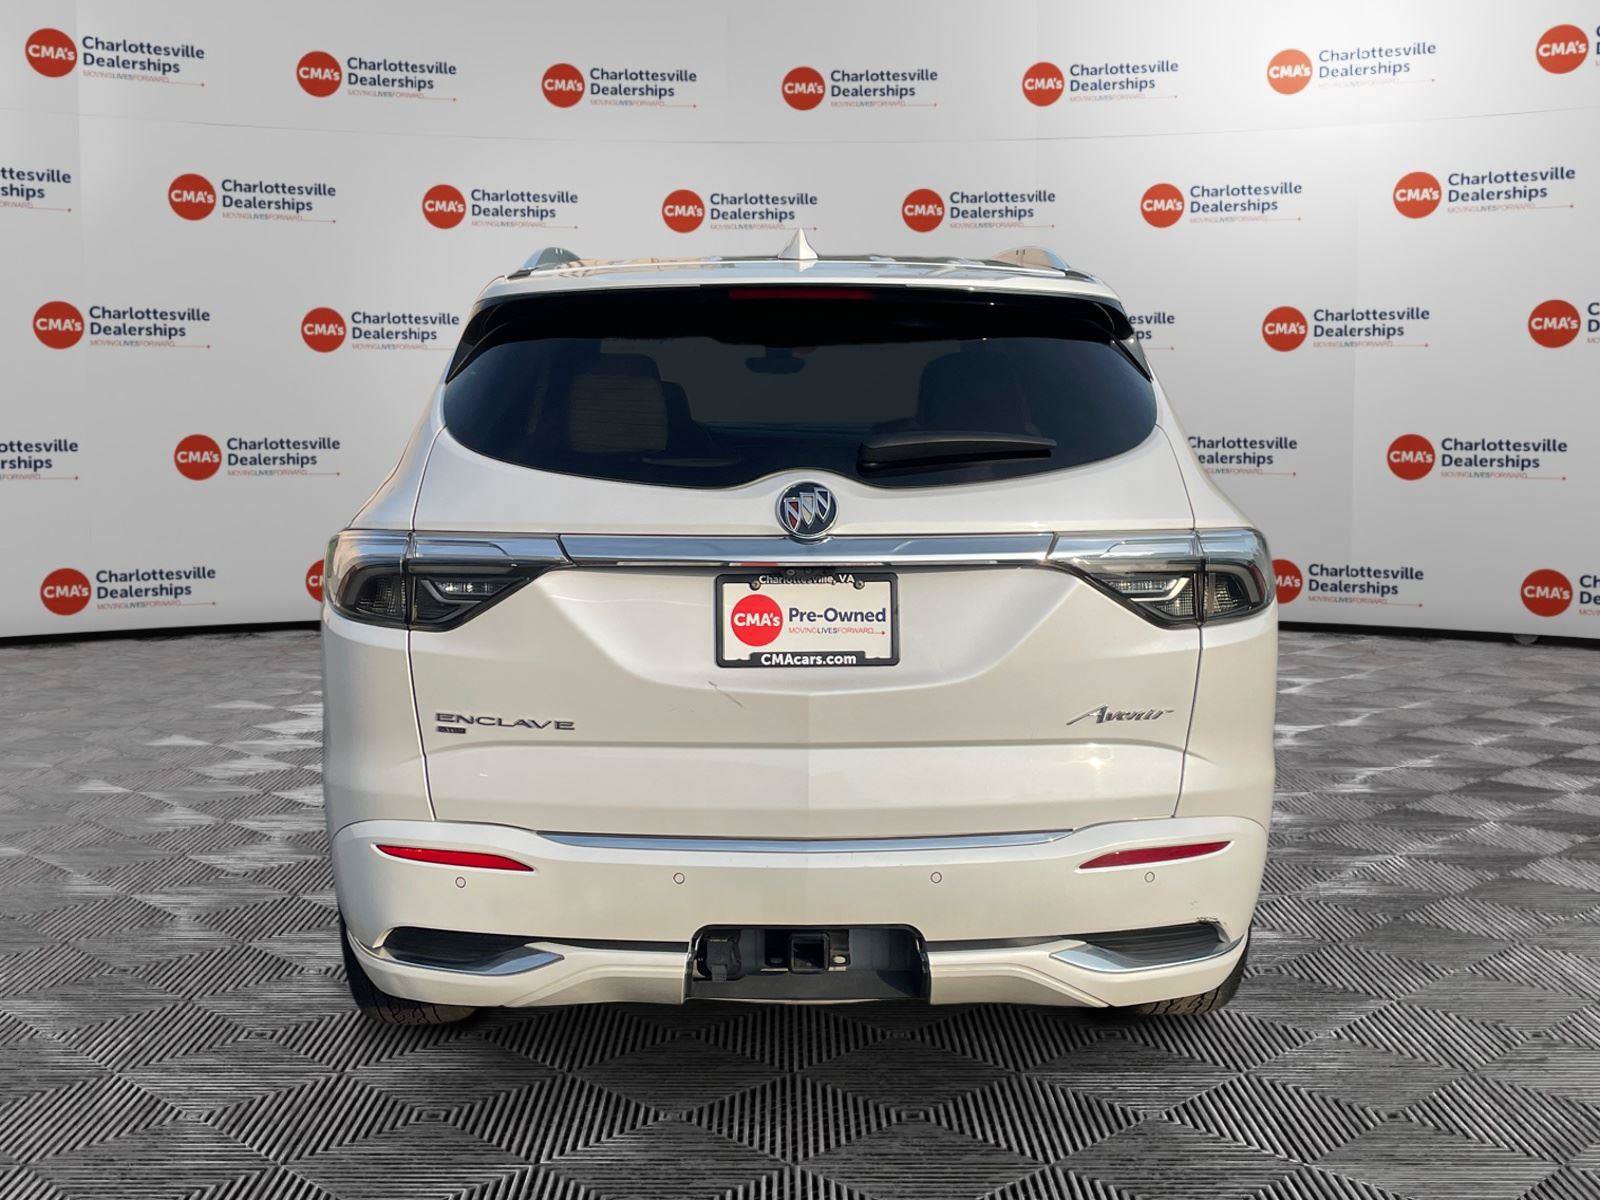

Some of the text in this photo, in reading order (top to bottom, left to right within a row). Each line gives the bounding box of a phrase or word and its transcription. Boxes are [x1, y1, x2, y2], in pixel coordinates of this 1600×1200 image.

[28, 44, 75, 61] CMA's
[82, 36, 205, 59] Charlottesville
[1318, 42, 1437, 63] Charlottesville
[1538, 40, 1587, 57] CMA's
[82, 53, 181, 75] Dealerships
[347, 57, 457, 75] Charlottesville
[1070, 60, 1179, 77] Charlottesville
[1269, 64, 1312, 79] CMA's
[1318, 60, 1411, 78] Dealerships
[299, 67, 341, 82] CMA's
[347, 73, 434, 91] Dealerships
[590, 67, 697, 83] Charlottesville
[830, 68, 938, 83] Charlottesville
[544, 78, 583, 92] CMA's
[590, 83, 675, 99] Dealerships
[784, 82, 824, 94] CMA's
[831, 84, 916, 99] Dealerships
[1024, 78, 1063, 91] CMA's
[1070, 77, 1155, 92] Dealerships
[1448, 166, 1576, 186] Charlottesville
[221, 179, 337, 197] Charlottesville
[1190, 182, 1302, 198] Charlottesville
[1396, 188, 1440, 203] CMA's
[1448, 186, 1548, 203] Dealerships
[171, 189, 215, 204] CMA's
[471, 188, 578, 204] Charlottesville
[710, 192, 818, 205] Charlottesville
[950, 190, 1056, 204] Charlottesville
[222, 195, 313, 214] Dealerships
[424, 200, 465, 213] CMA's
[471, 204, 556, 220] Dealerships
[664, 204, 704, 217] CMA's
[904, 204, 944, 217] CMA's
[1143, 198, 1183, 212] CMA's
[1190, 199, 1278, 214] Dealerships
[710, 208, 795, 222] Dealerships
[950, 206, 1034, 220] Dealerships
[89, 306, 211, 322] Charlottesville
[351, 311, 460, 326] Charlottesville
[1313, 307, 1430, 322] Charlottesville
[36, 317, 82, 332] CMA's
[90, 321, 187, 340] Dealerships
[303, 322, 345, 337] CMA's
[1264, 321, 1307, 335] CMA's
[1531, 316, 1579, 330] CMA's
[351, 327, 437, 342] Dealerships
[1313, 323, 1405, 339] Dealerships
[227, 436, 341, 451] Charlottesville
[1441, 437, 1568, 453] Charlottesville
[177, 450, 220, 464] CMA's
[227, 452, 318, 468] Dealerships
[1198, 452, 1274, 468] ealerships
[1390, 450, 1433, 464] CMA's
[1441, 453, 1541, 471] Dealerships
[96, 566, 216, 583] Charlottesville
[838, 574, 856, 584] VA
[1308, 563, 1425, 581] Charlottesville
[43, 584, 89, 599] CMA's
[96, 583, 192, 600] Dealerships
[1308, 579, 1399, 598] Dealerships
[1523, 585, 1571, 600] CMA's
[733, 612, 782, 628] CMA's
[788, 607, 887, 623] Pre-Owned
[760, 653, 858, 666] CMAcars.com
[435, 712, 576, 731] ENCLAVE
